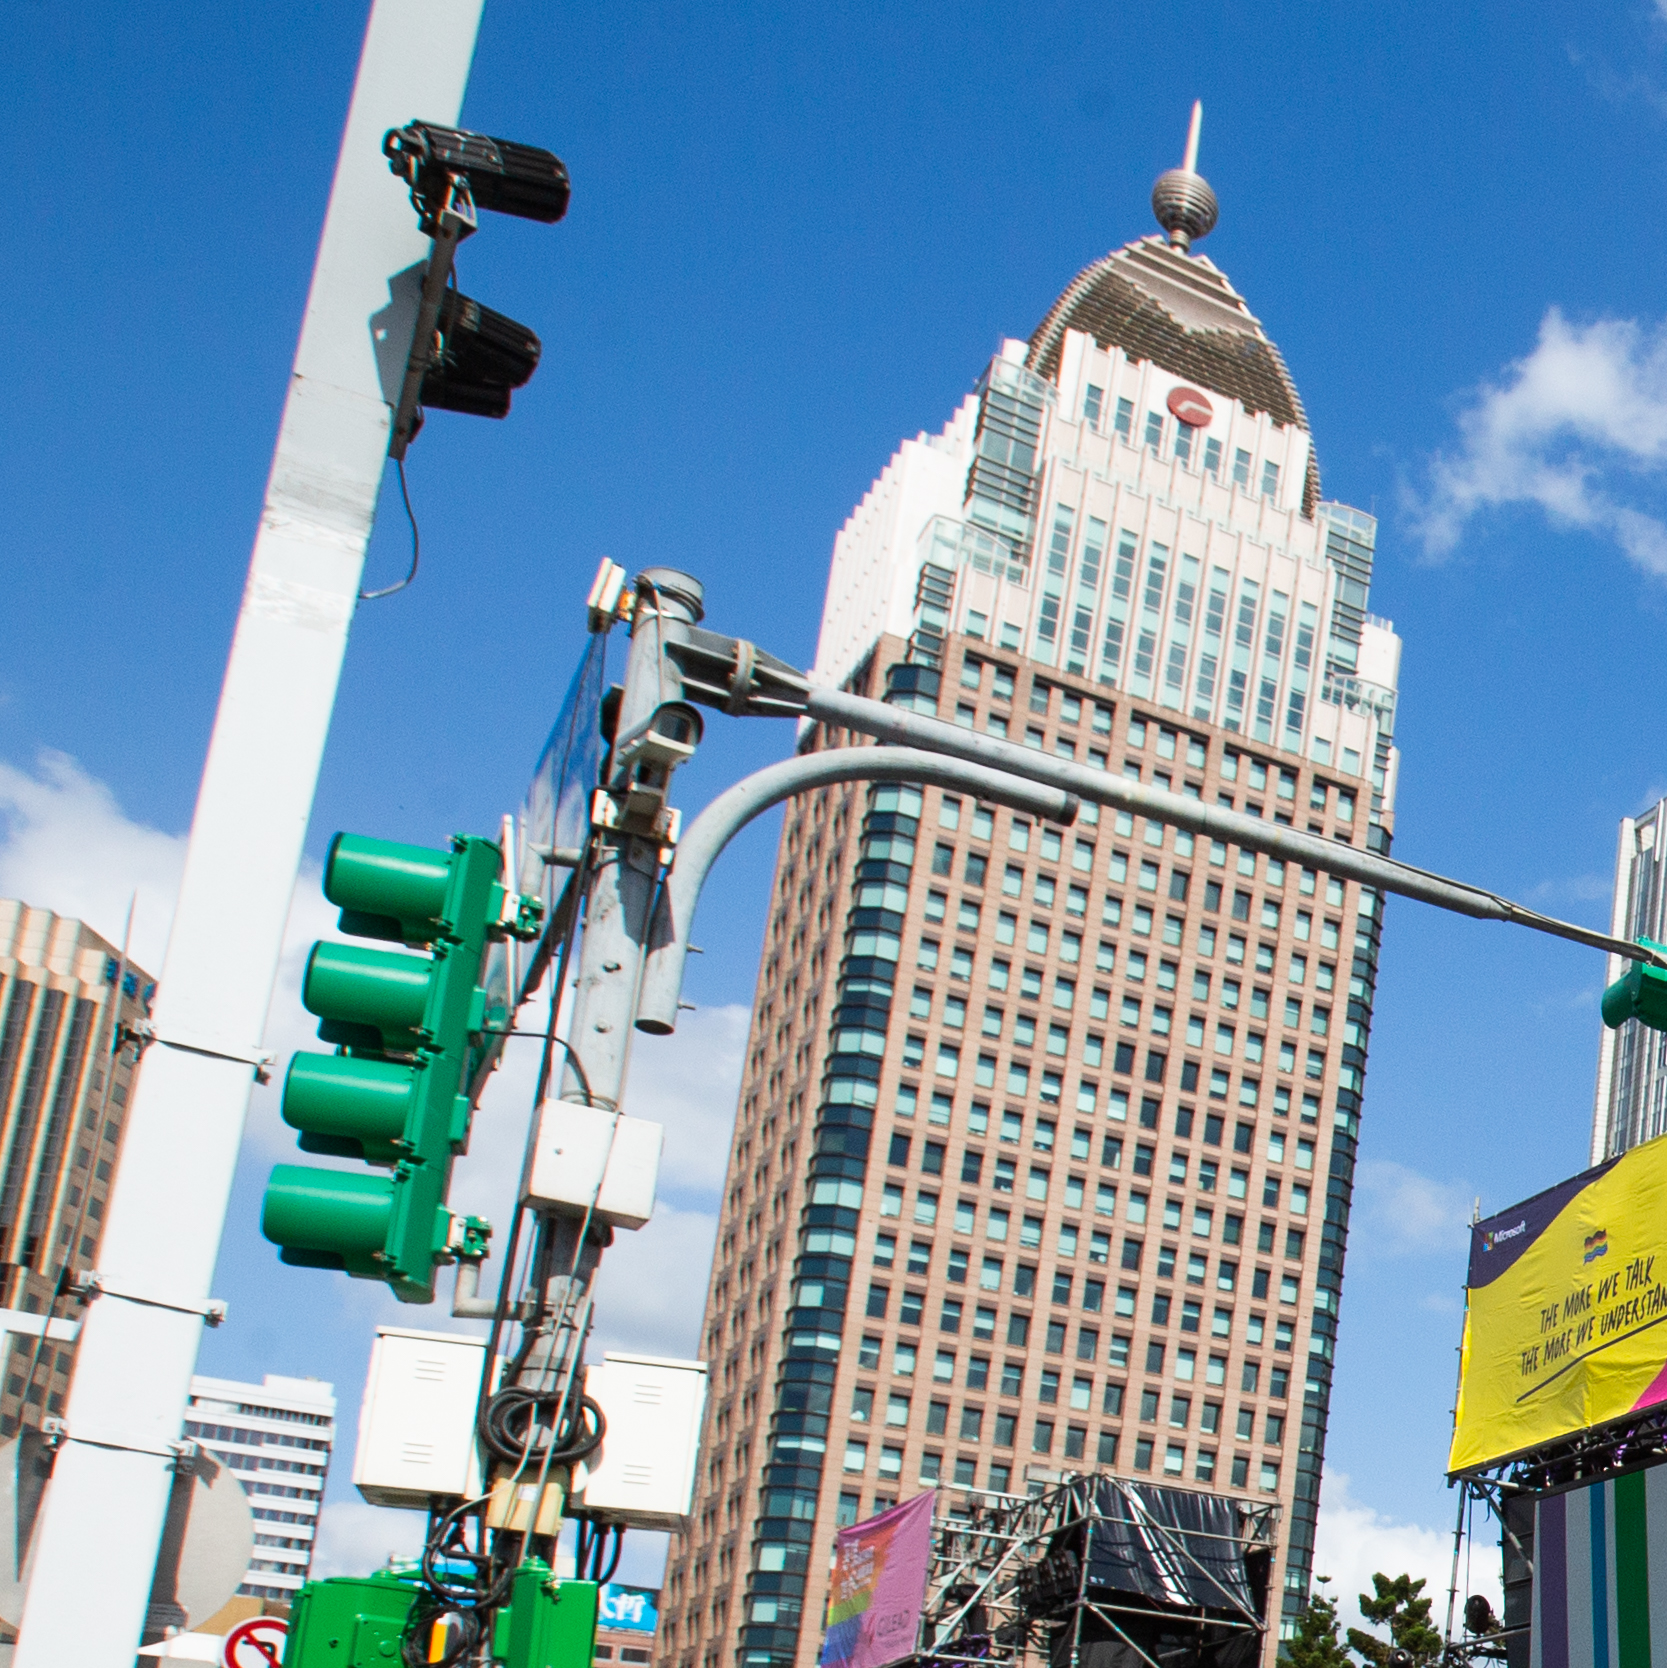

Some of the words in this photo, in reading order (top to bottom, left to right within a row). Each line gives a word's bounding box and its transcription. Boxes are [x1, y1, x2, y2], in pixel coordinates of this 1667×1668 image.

[1494, 1220, 1526, 1244] Microsoft
[1540, 1302, 1558, 1334] THE
[1563, 1284, 1591, 1322] MORE
[1597, 1271, 1620, 1304] WE
[1626, 1255, 1655, 1292] TALK
[1521, 1345, 1540, 1377] THE
[1543, 1327, 1572, 1366] MORE
[1576, 1315, 1596, 1349] WE
